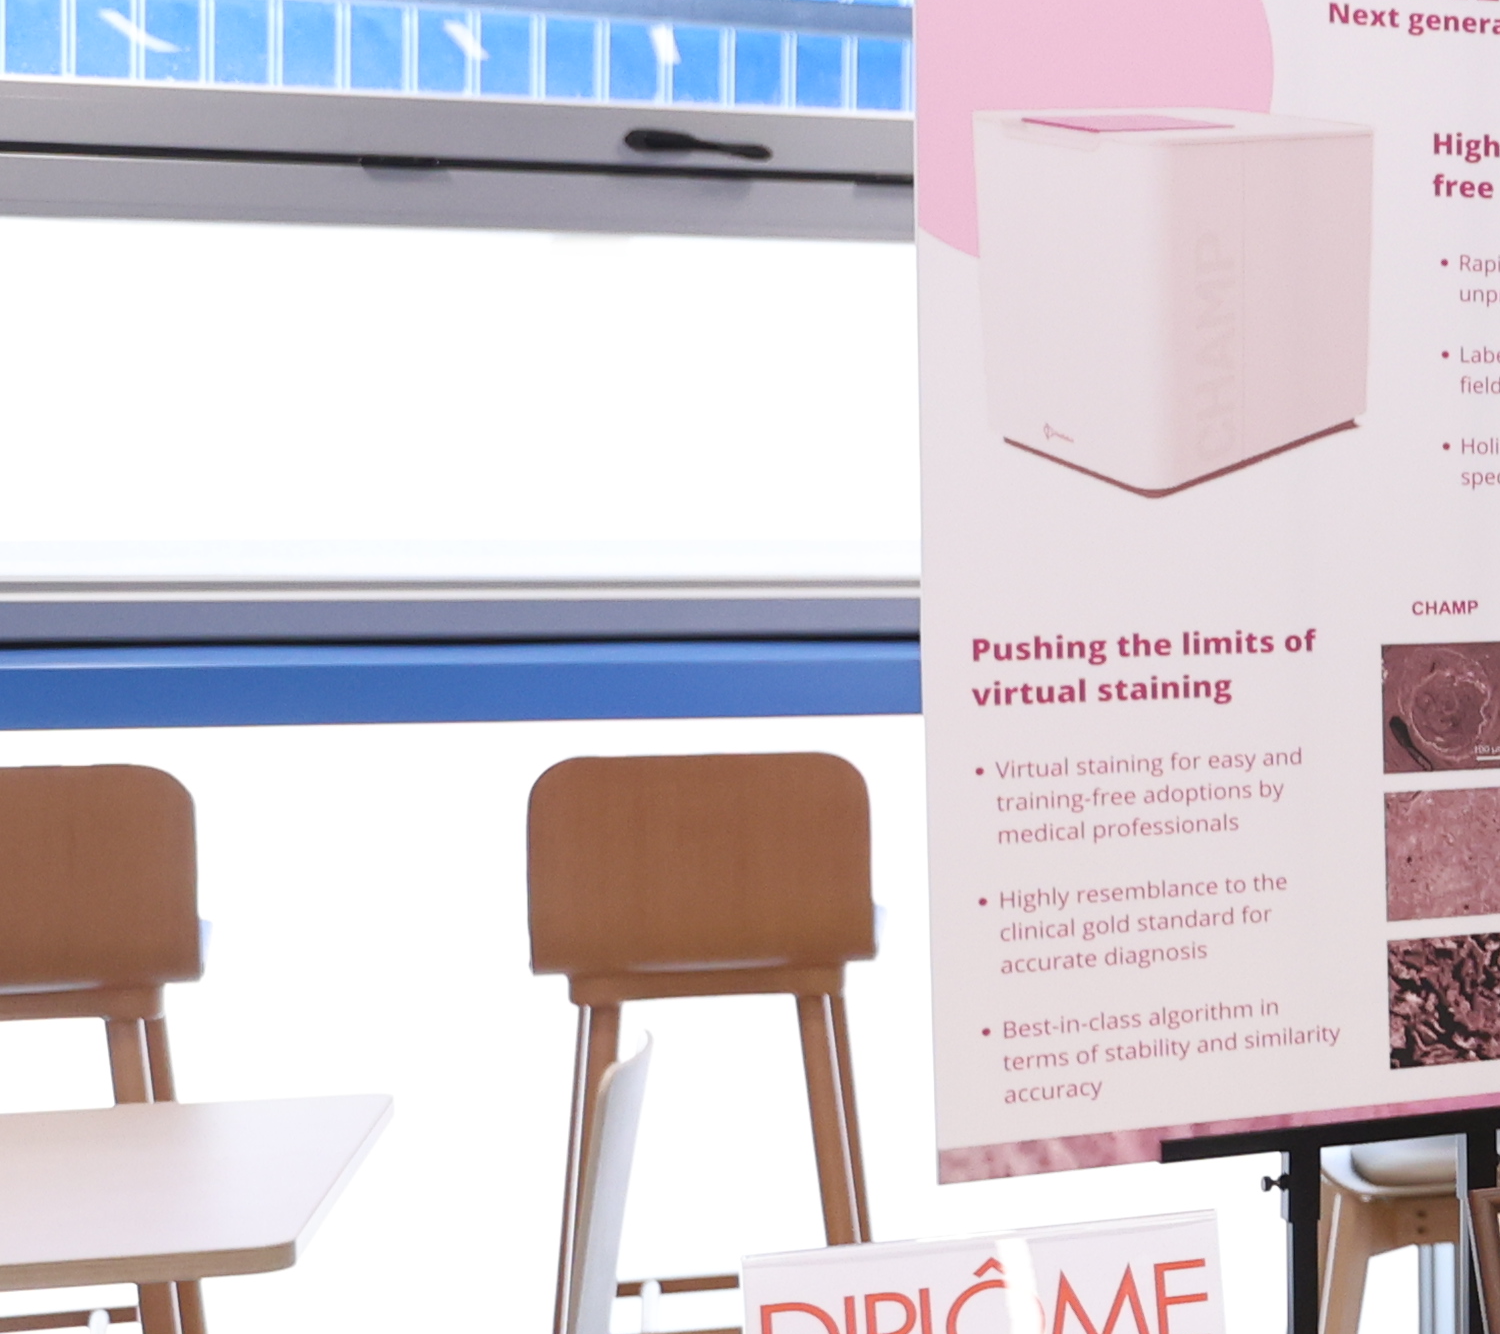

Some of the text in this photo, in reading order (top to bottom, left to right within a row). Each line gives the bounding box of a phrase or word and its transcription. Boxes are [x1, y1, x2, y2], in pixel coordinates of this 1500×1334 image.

[1329, 2, 1400, 28] Next
[1433, 174, 1494, 199] free
[1460, 376, 1500, 395] field
[1412, 600, 1479, 616] CHAMP
[972, 628, 1316, 665] Pushing the limits of
[972, 675, 1232, 706] virtual staining
[996, 747, 1302, 779] Virtual staining for easy and
[997, 780, 1284, 813] training-free adoptions by
[998, 813, 1239, 845] medical professionals
[999, 873, 1288, 913] Highly resemblance to the
[1000, 906, 1271, 942] clinical gold standard for
[1001, 941, 1208, 975] accurate diagnosis
[1003, 999, 1279, 1039] Best-in-class algorithm in
[1003, 1025, 1340, 1072] terms of stability and similarity
[1004, 1081, 1102, 1104] accuracy
